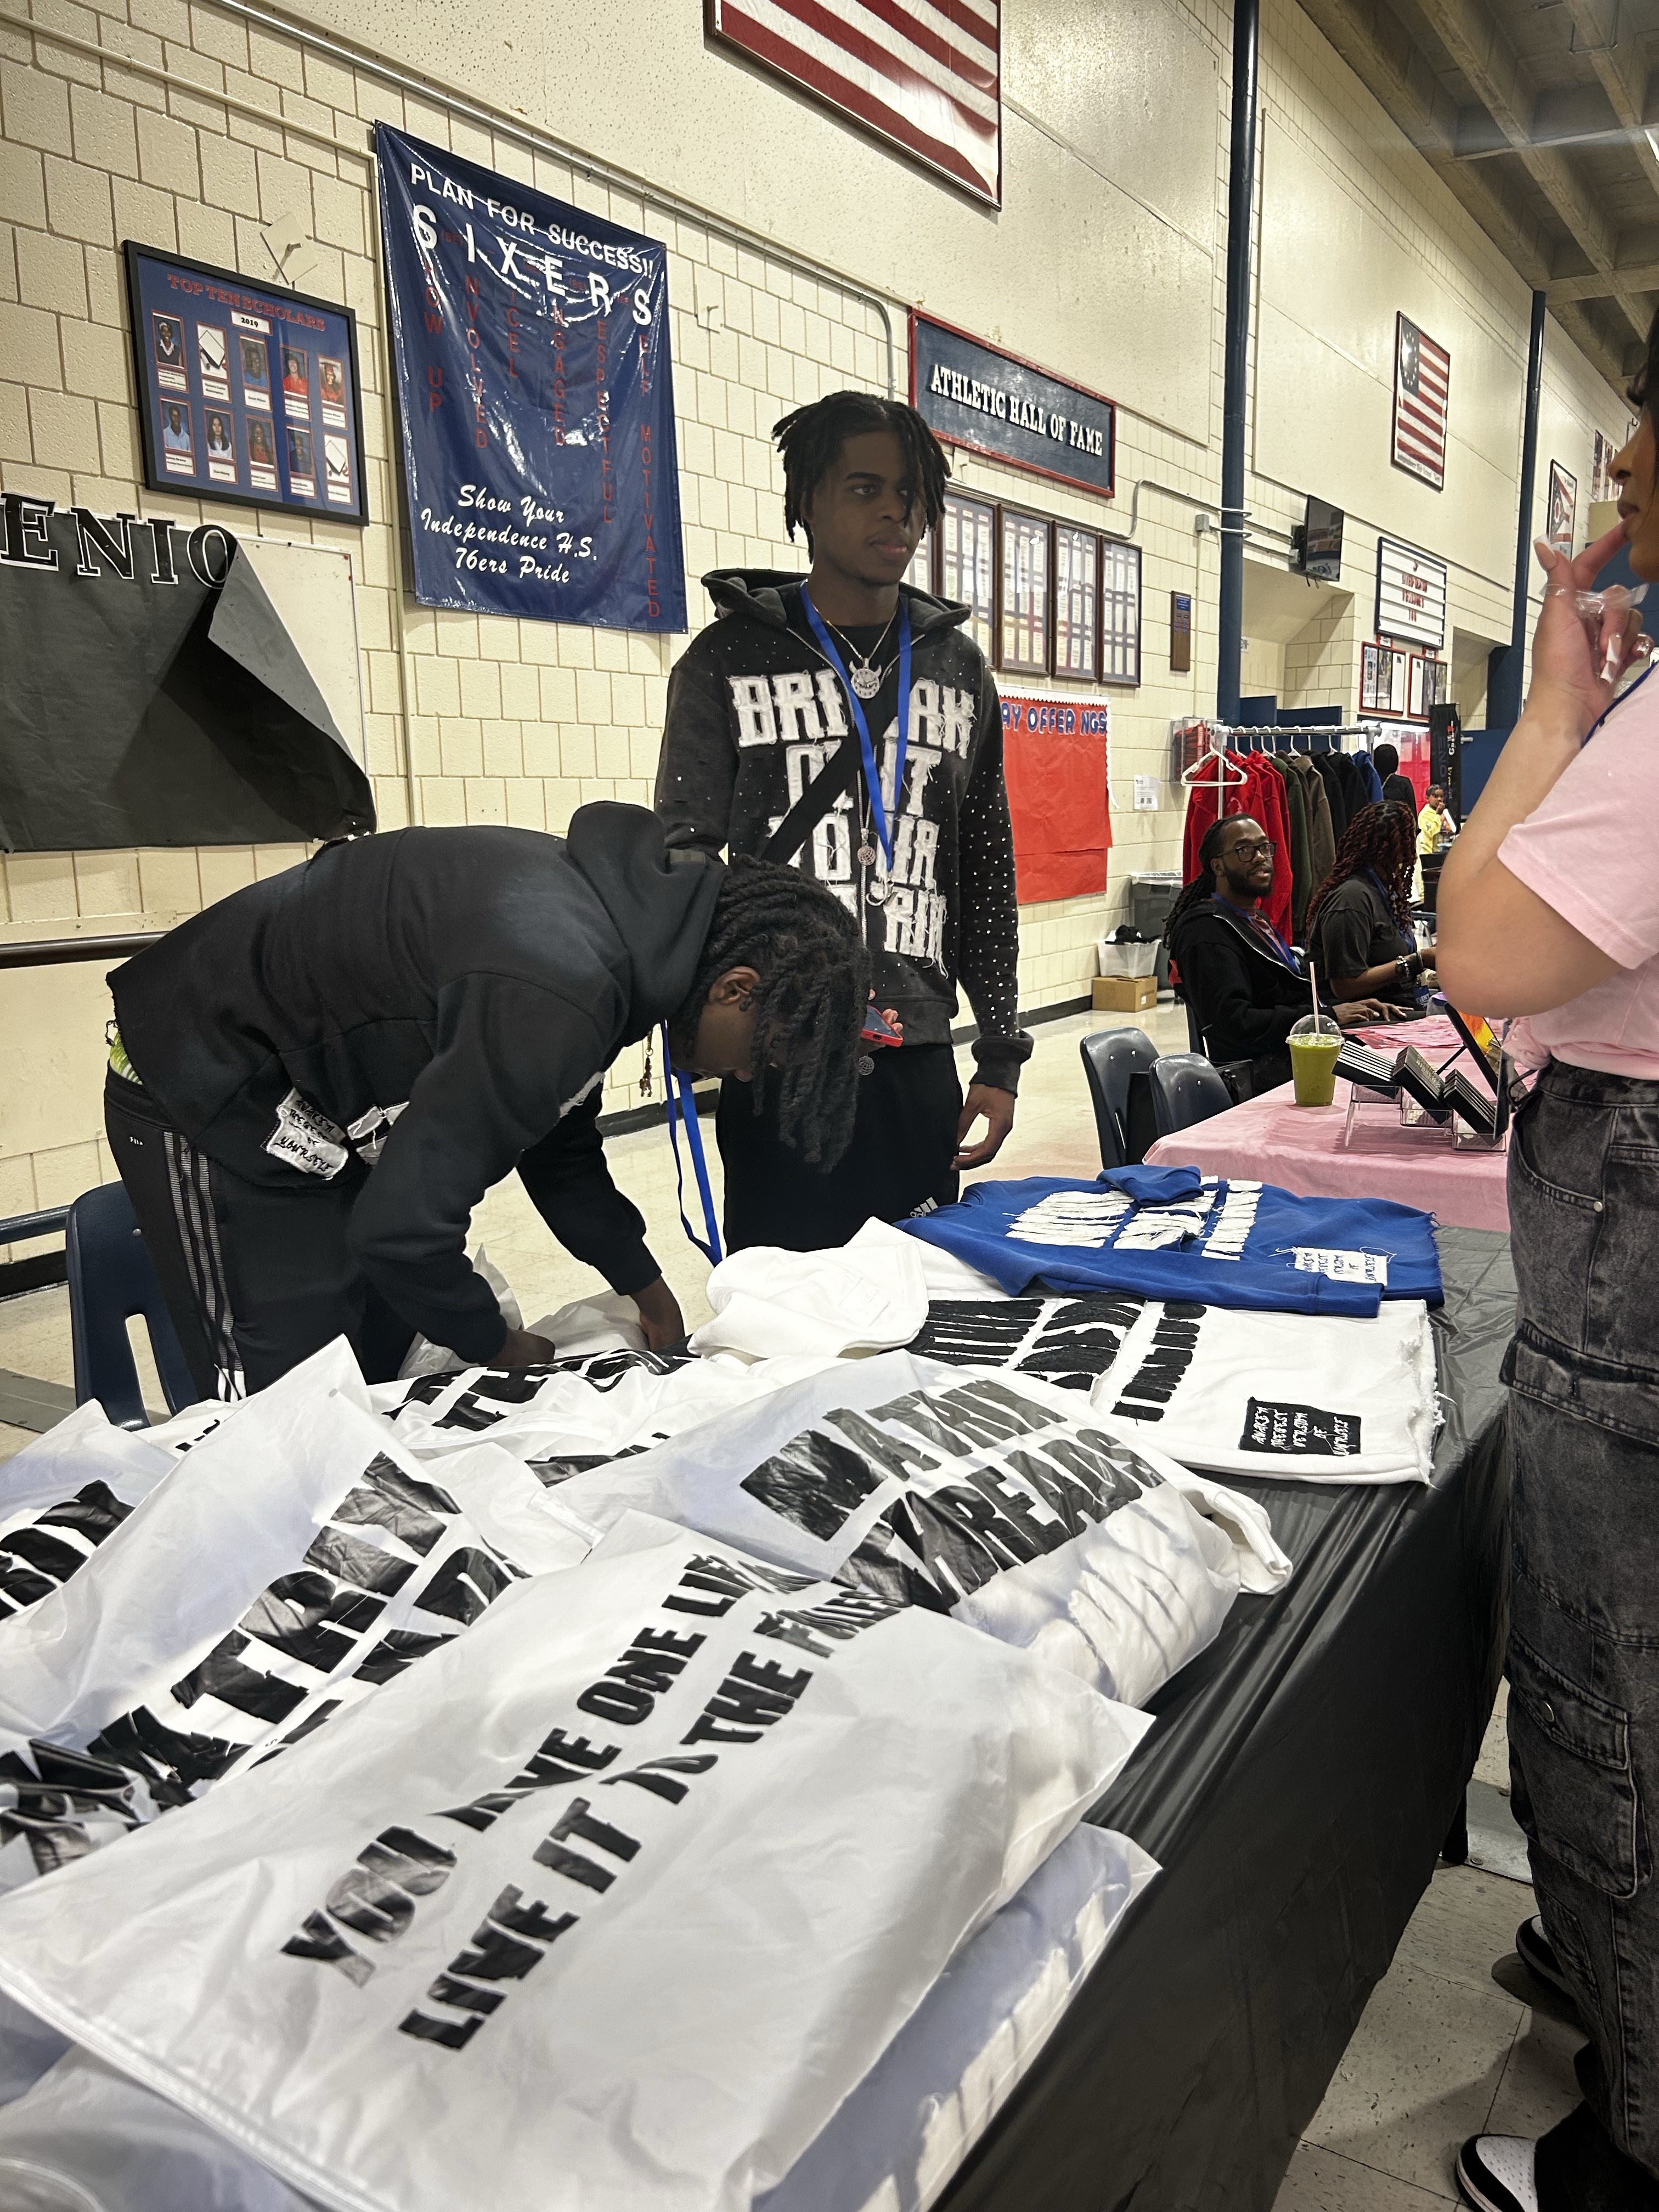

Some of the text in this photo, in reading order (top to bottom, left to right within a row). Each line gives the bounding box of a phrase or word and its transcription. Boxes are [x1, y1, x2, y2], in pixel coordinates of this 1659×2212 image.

[411, 163, 654, 279] PLAN FOR SUCCESS!!
[167, 273, 326, 331] TOP TEN SCHOLARS
[240, 317, 259, 329] 2019
[930, 364, 1103, 456] ATHLETIC HALL OF FAME
[420, 508, 598, 561] Independence H.S.
[458, 484, 565, 527] Show Your
[455, 547, 571, 584] 76ers Pride
[280, 1825, 459, 1988] YOU
[576, 1626, 708, 1725] ONE
[398, 1882, 581, 2050] LIVE
[532, 1796, 642, 1894] IT
[679, 1650, 814, 1746] THE
